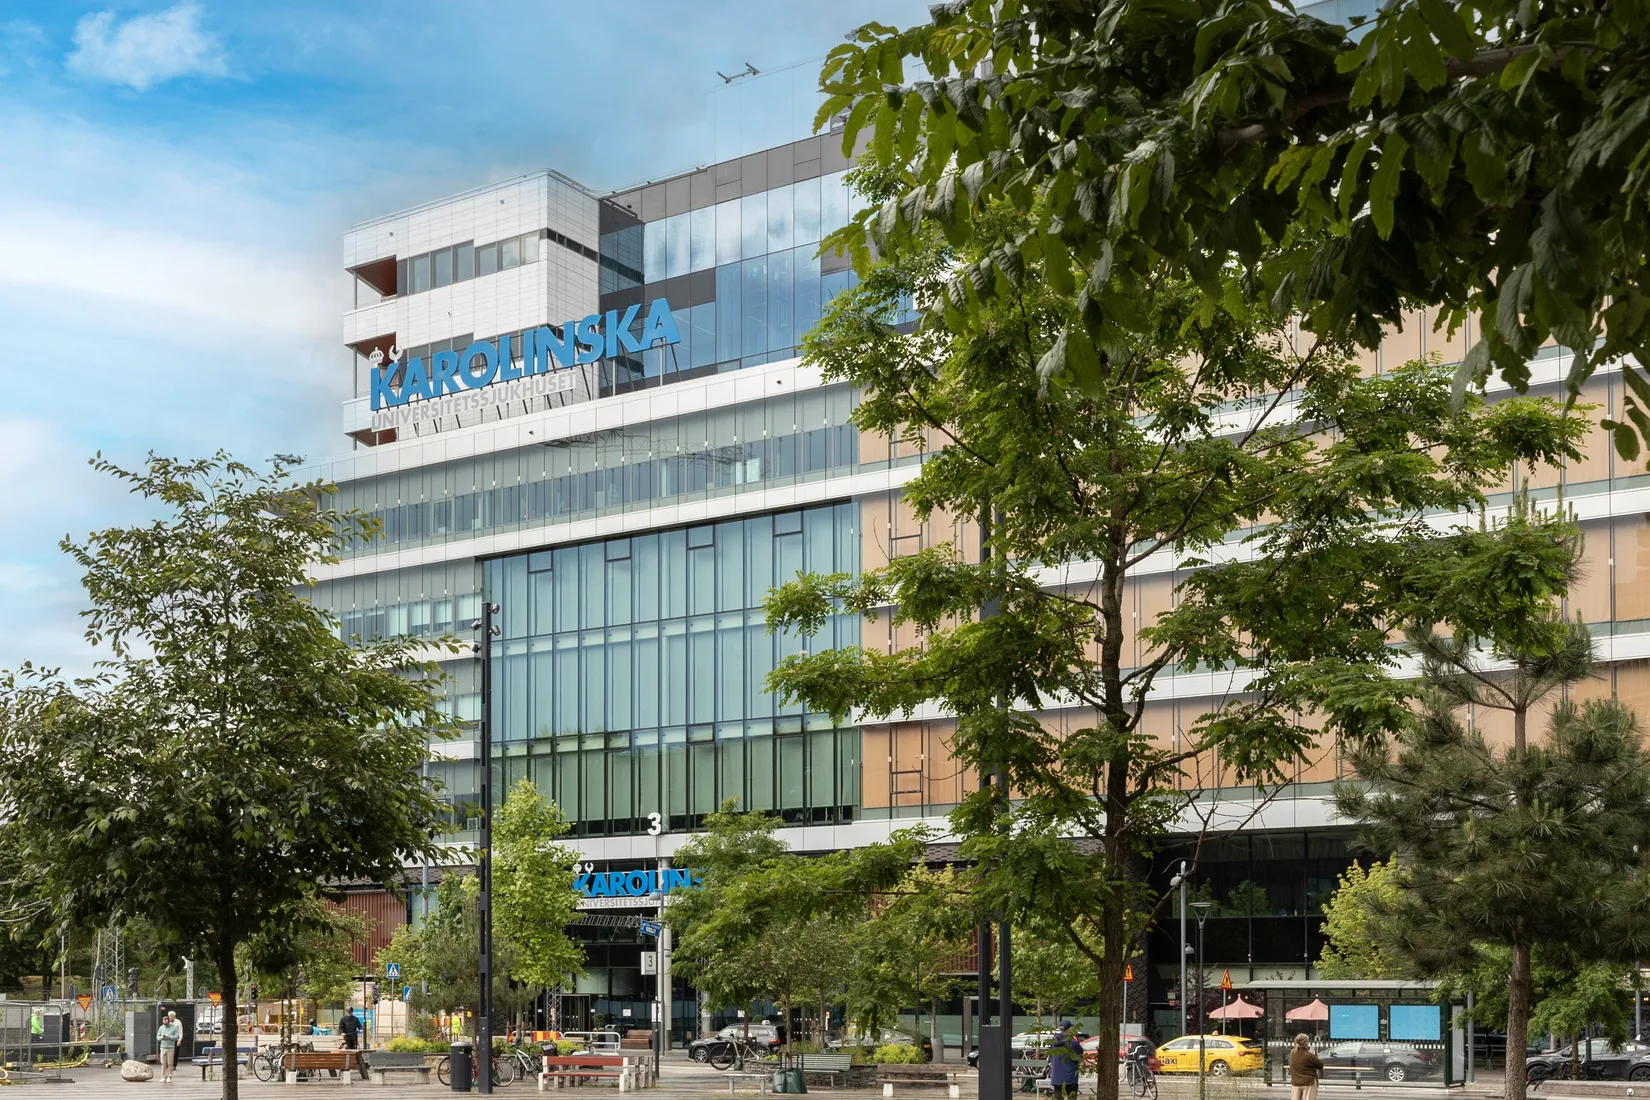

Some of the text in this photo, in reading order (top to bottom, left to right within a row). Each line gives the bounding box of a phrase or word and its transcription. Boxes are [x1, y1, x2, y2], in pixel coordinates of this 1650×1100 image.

[370, 297, 681, 411] KAROLINSKA
[372, 372, 576, 430] UNIVERSITETSSJUKHUSET
[647, 812, 662, 836] 3
[648, 955, 654, 968] 3
